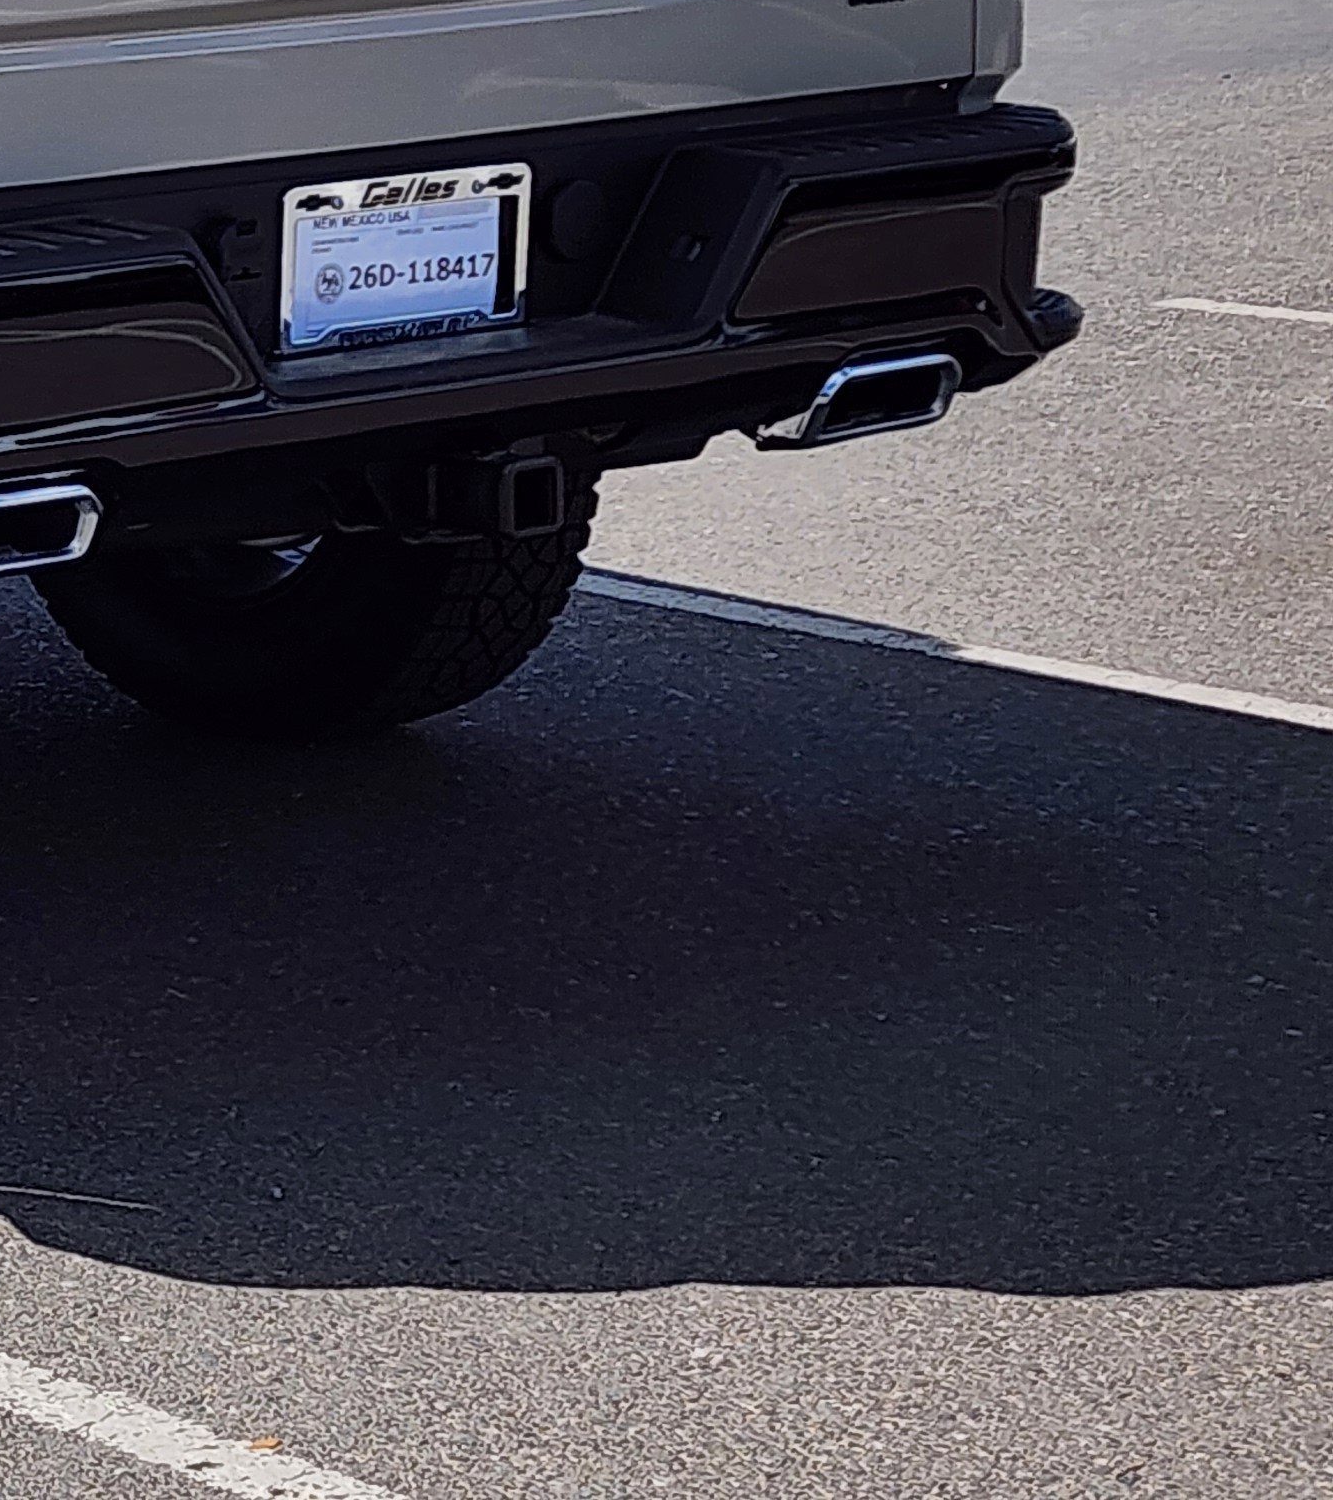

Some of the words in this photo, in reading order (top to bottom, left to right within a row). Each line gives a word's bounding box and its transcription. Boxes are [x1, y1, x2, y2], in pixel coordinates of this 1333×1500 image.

[359, 177, 459, 209] Galles
[342, 213, 385, 227] MEXICO
[348, 253, 496, 291] 26D-118417
